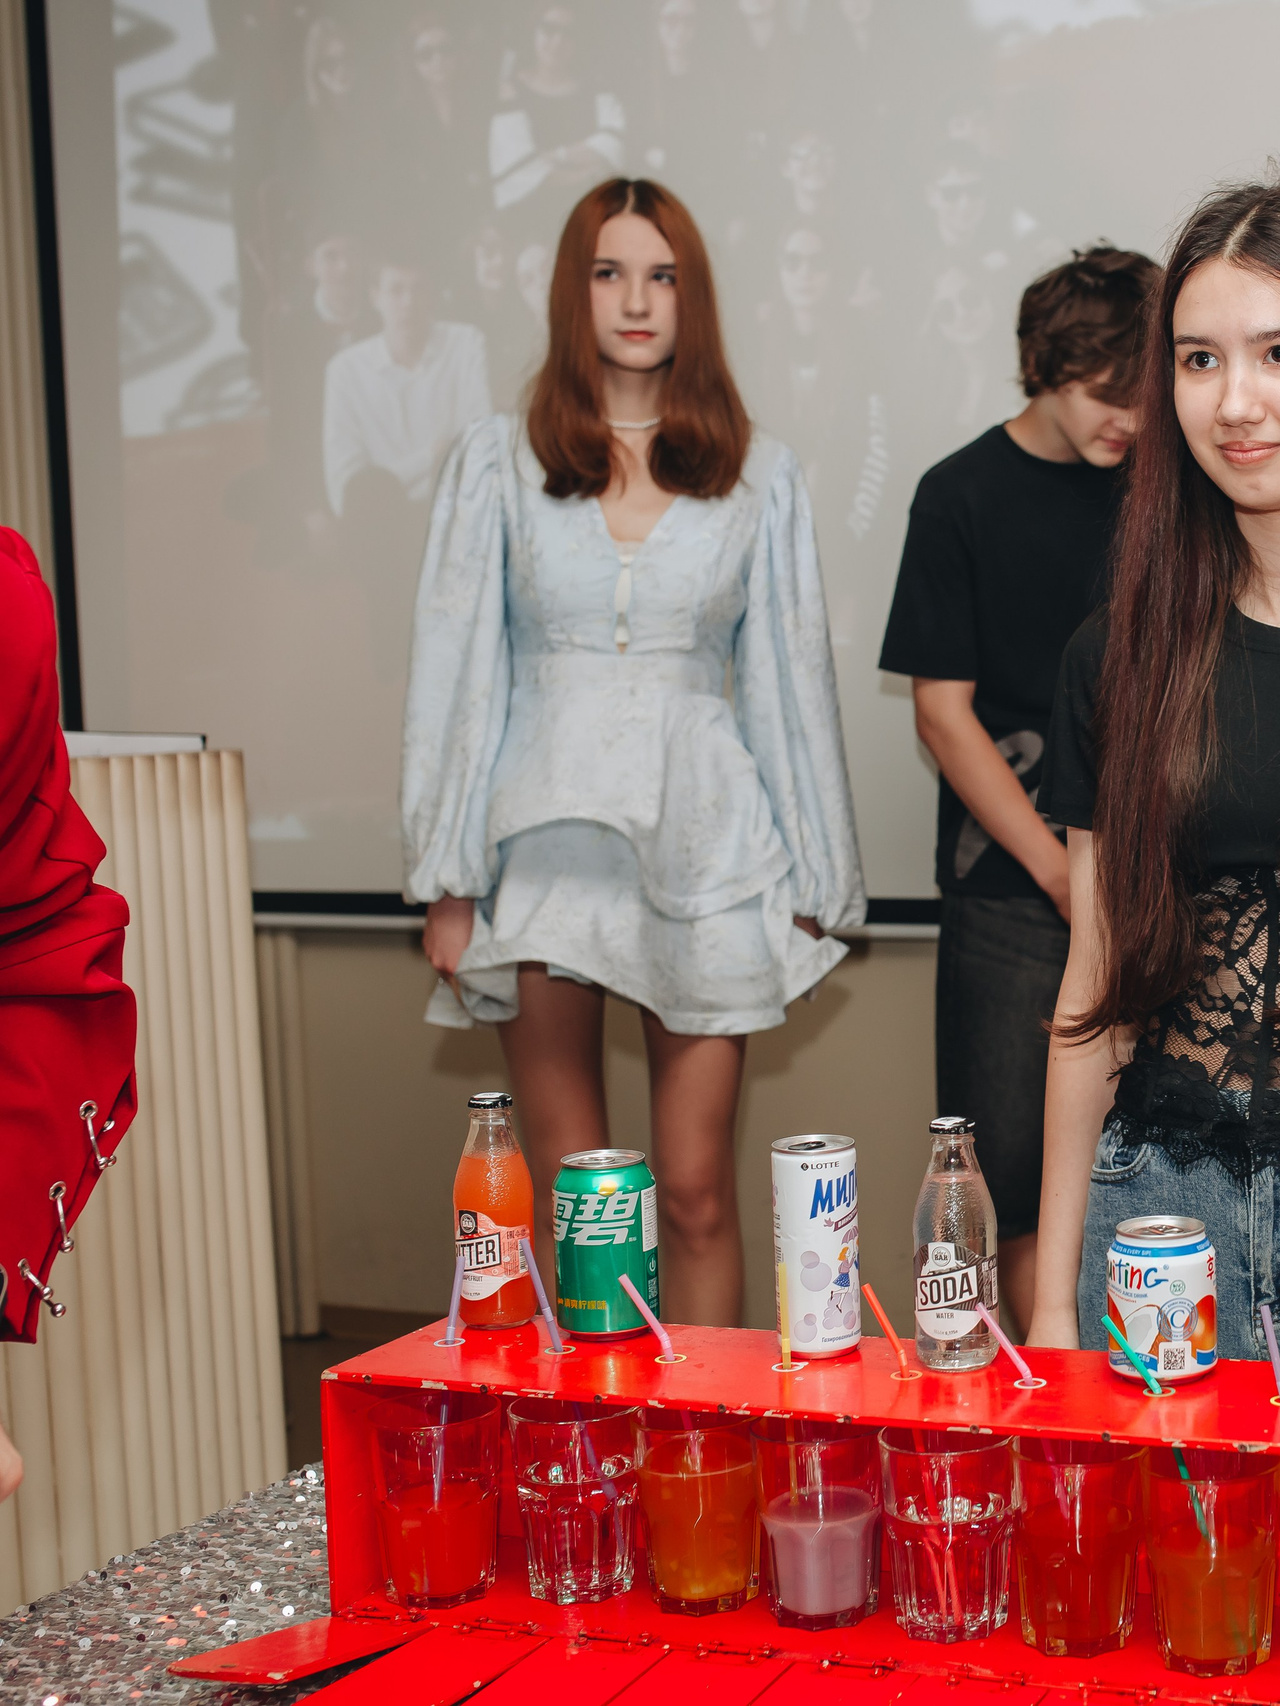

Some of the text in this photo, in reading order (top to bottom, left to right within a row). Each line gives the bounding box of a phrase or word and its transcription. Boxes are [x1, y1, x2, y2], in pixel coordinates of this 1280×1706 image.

[811, 1161, 840, 1170] LOTTE
[455, 1239, 497, 1268] ITTER
[934, 1253, 949, 1261] BAR
[920, 1272, 974, 1306] SODA
